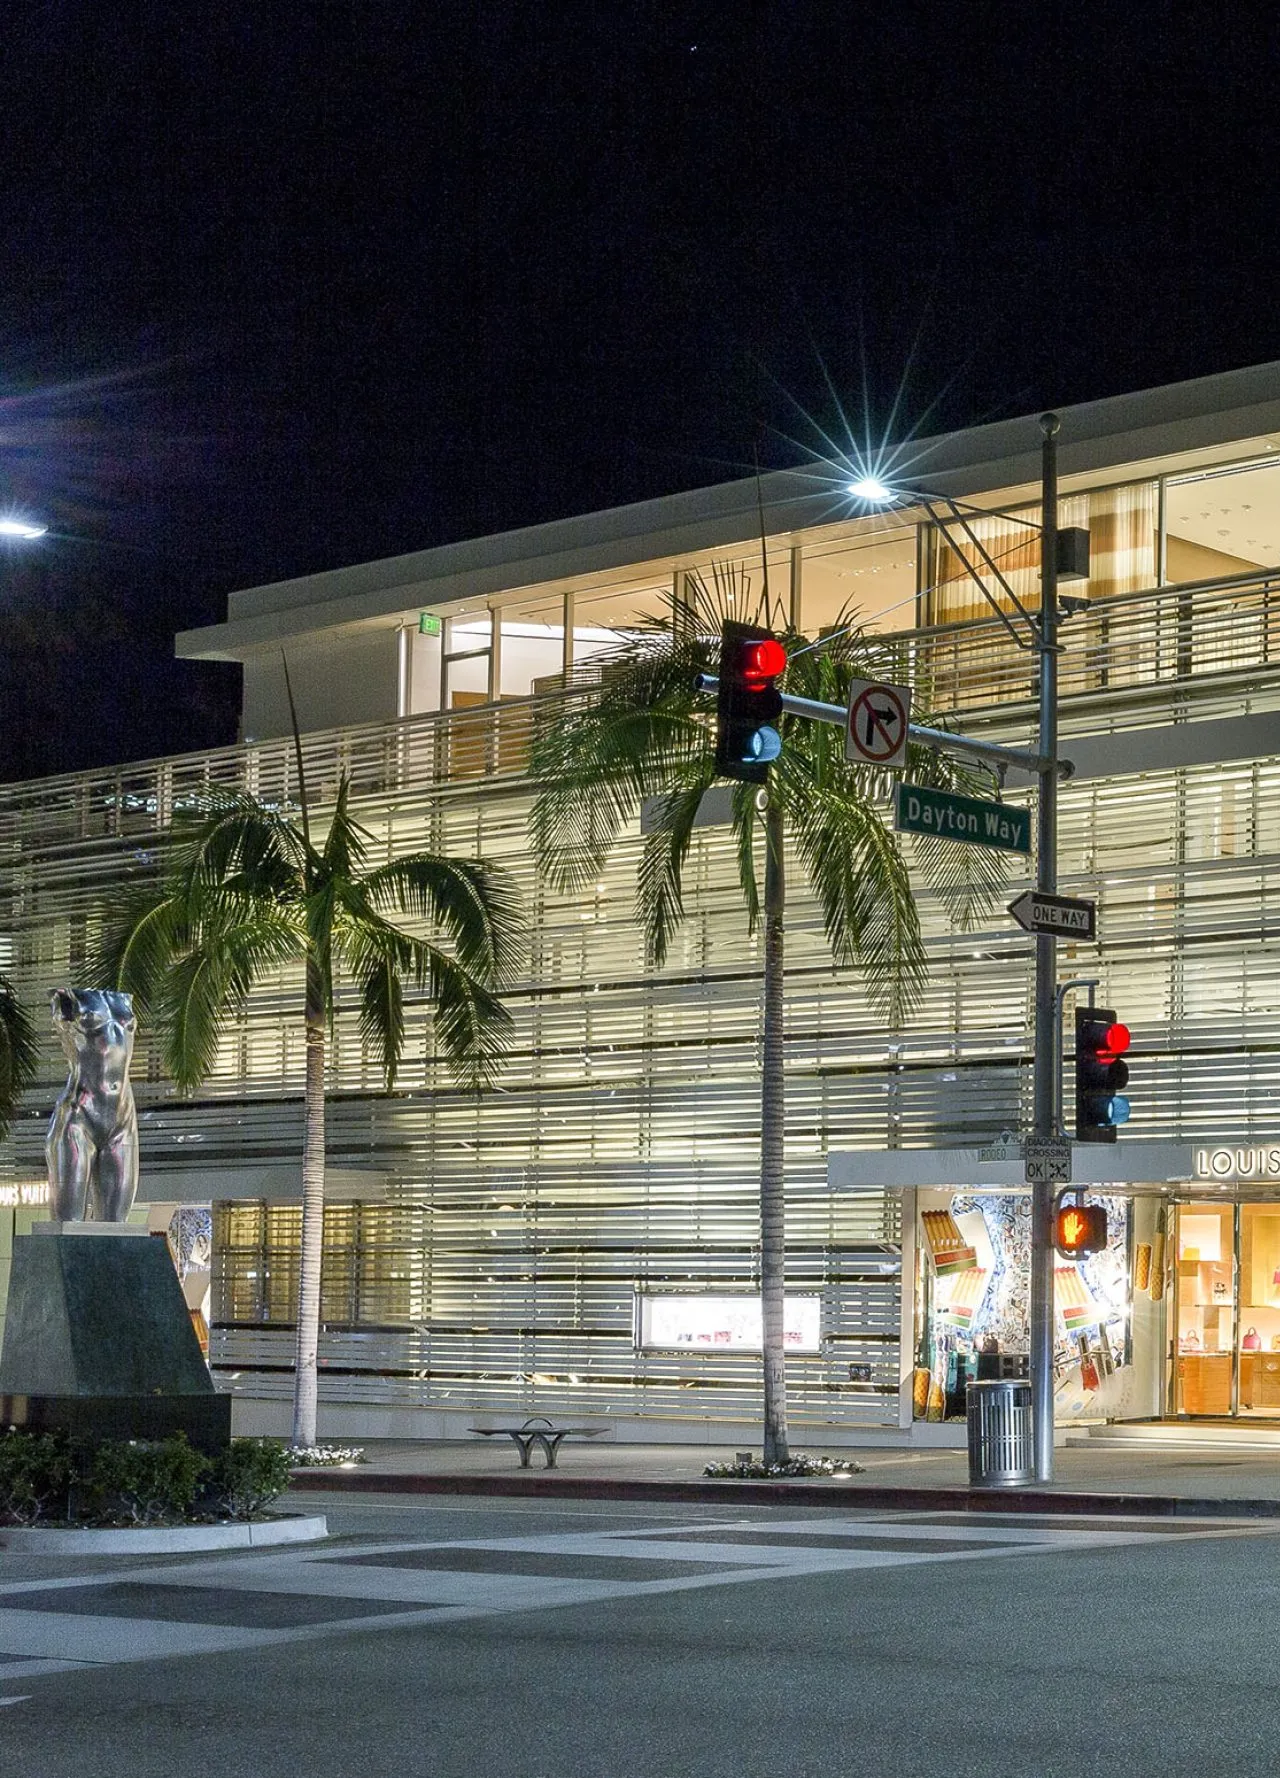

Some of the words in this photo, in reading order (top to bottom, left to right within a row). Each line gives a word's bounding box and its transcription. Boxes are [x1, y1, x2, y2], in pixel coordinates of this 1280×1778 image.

[908, 797, 978, 832] Dayton
[985, 812, 1022, 847] Way
[1033, 905, 1057, 924] ONE
[1062, 909, 1086, 928] WAY
[1027, 1137, 1069, 1146] DIAGONAL
[981, 1148, 1007, 1161] RODEO
[1027, 1148, 1070, 1157] CROSSING
[1027, 1163, 1043, 1177] OK
